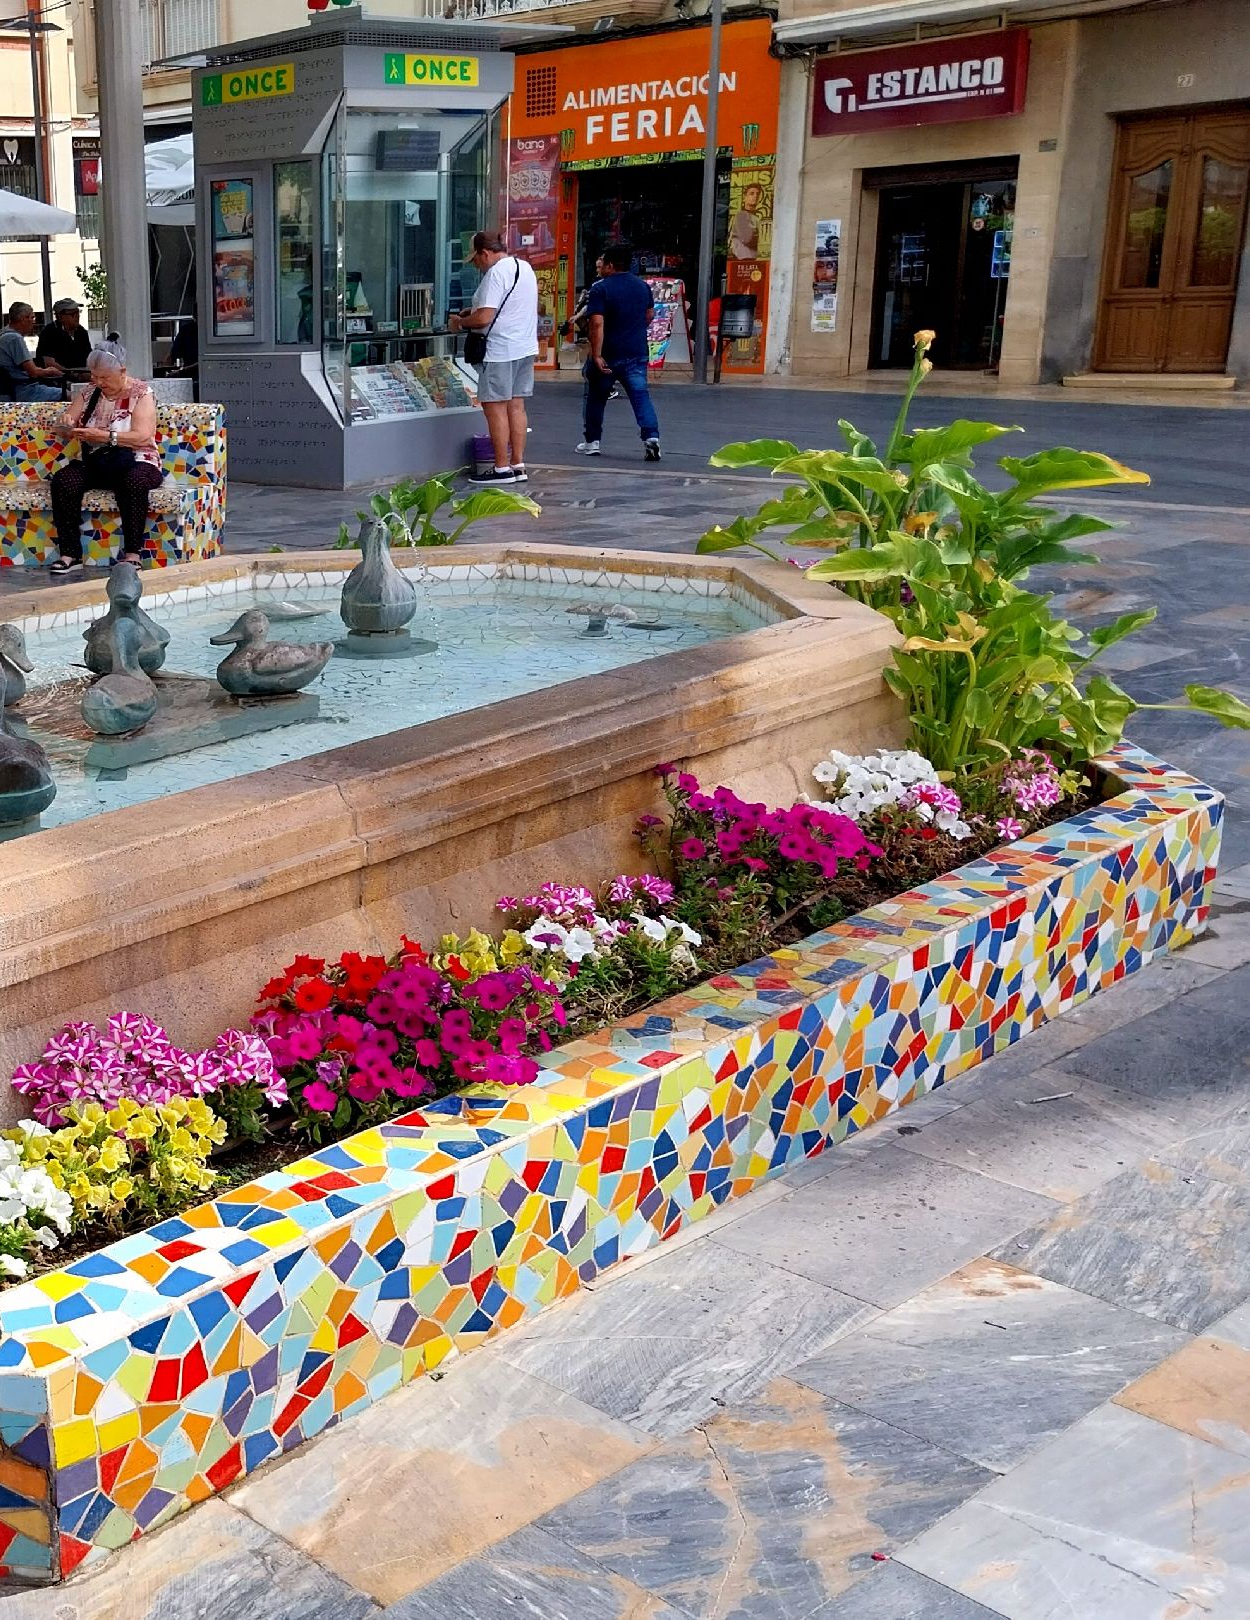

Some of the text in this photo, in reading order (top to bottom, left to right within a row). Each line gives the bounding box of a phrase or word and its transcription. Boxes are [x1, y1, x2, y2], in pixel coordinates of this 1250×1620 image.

[229, 69, 287, 97] ONCE
[413, 59, 471, 81] ONCE
[866, 56, 1004, 101] ESTANCO
[586, 104, 705, 145] FERIA
[517, 139, 545, 151] bang
